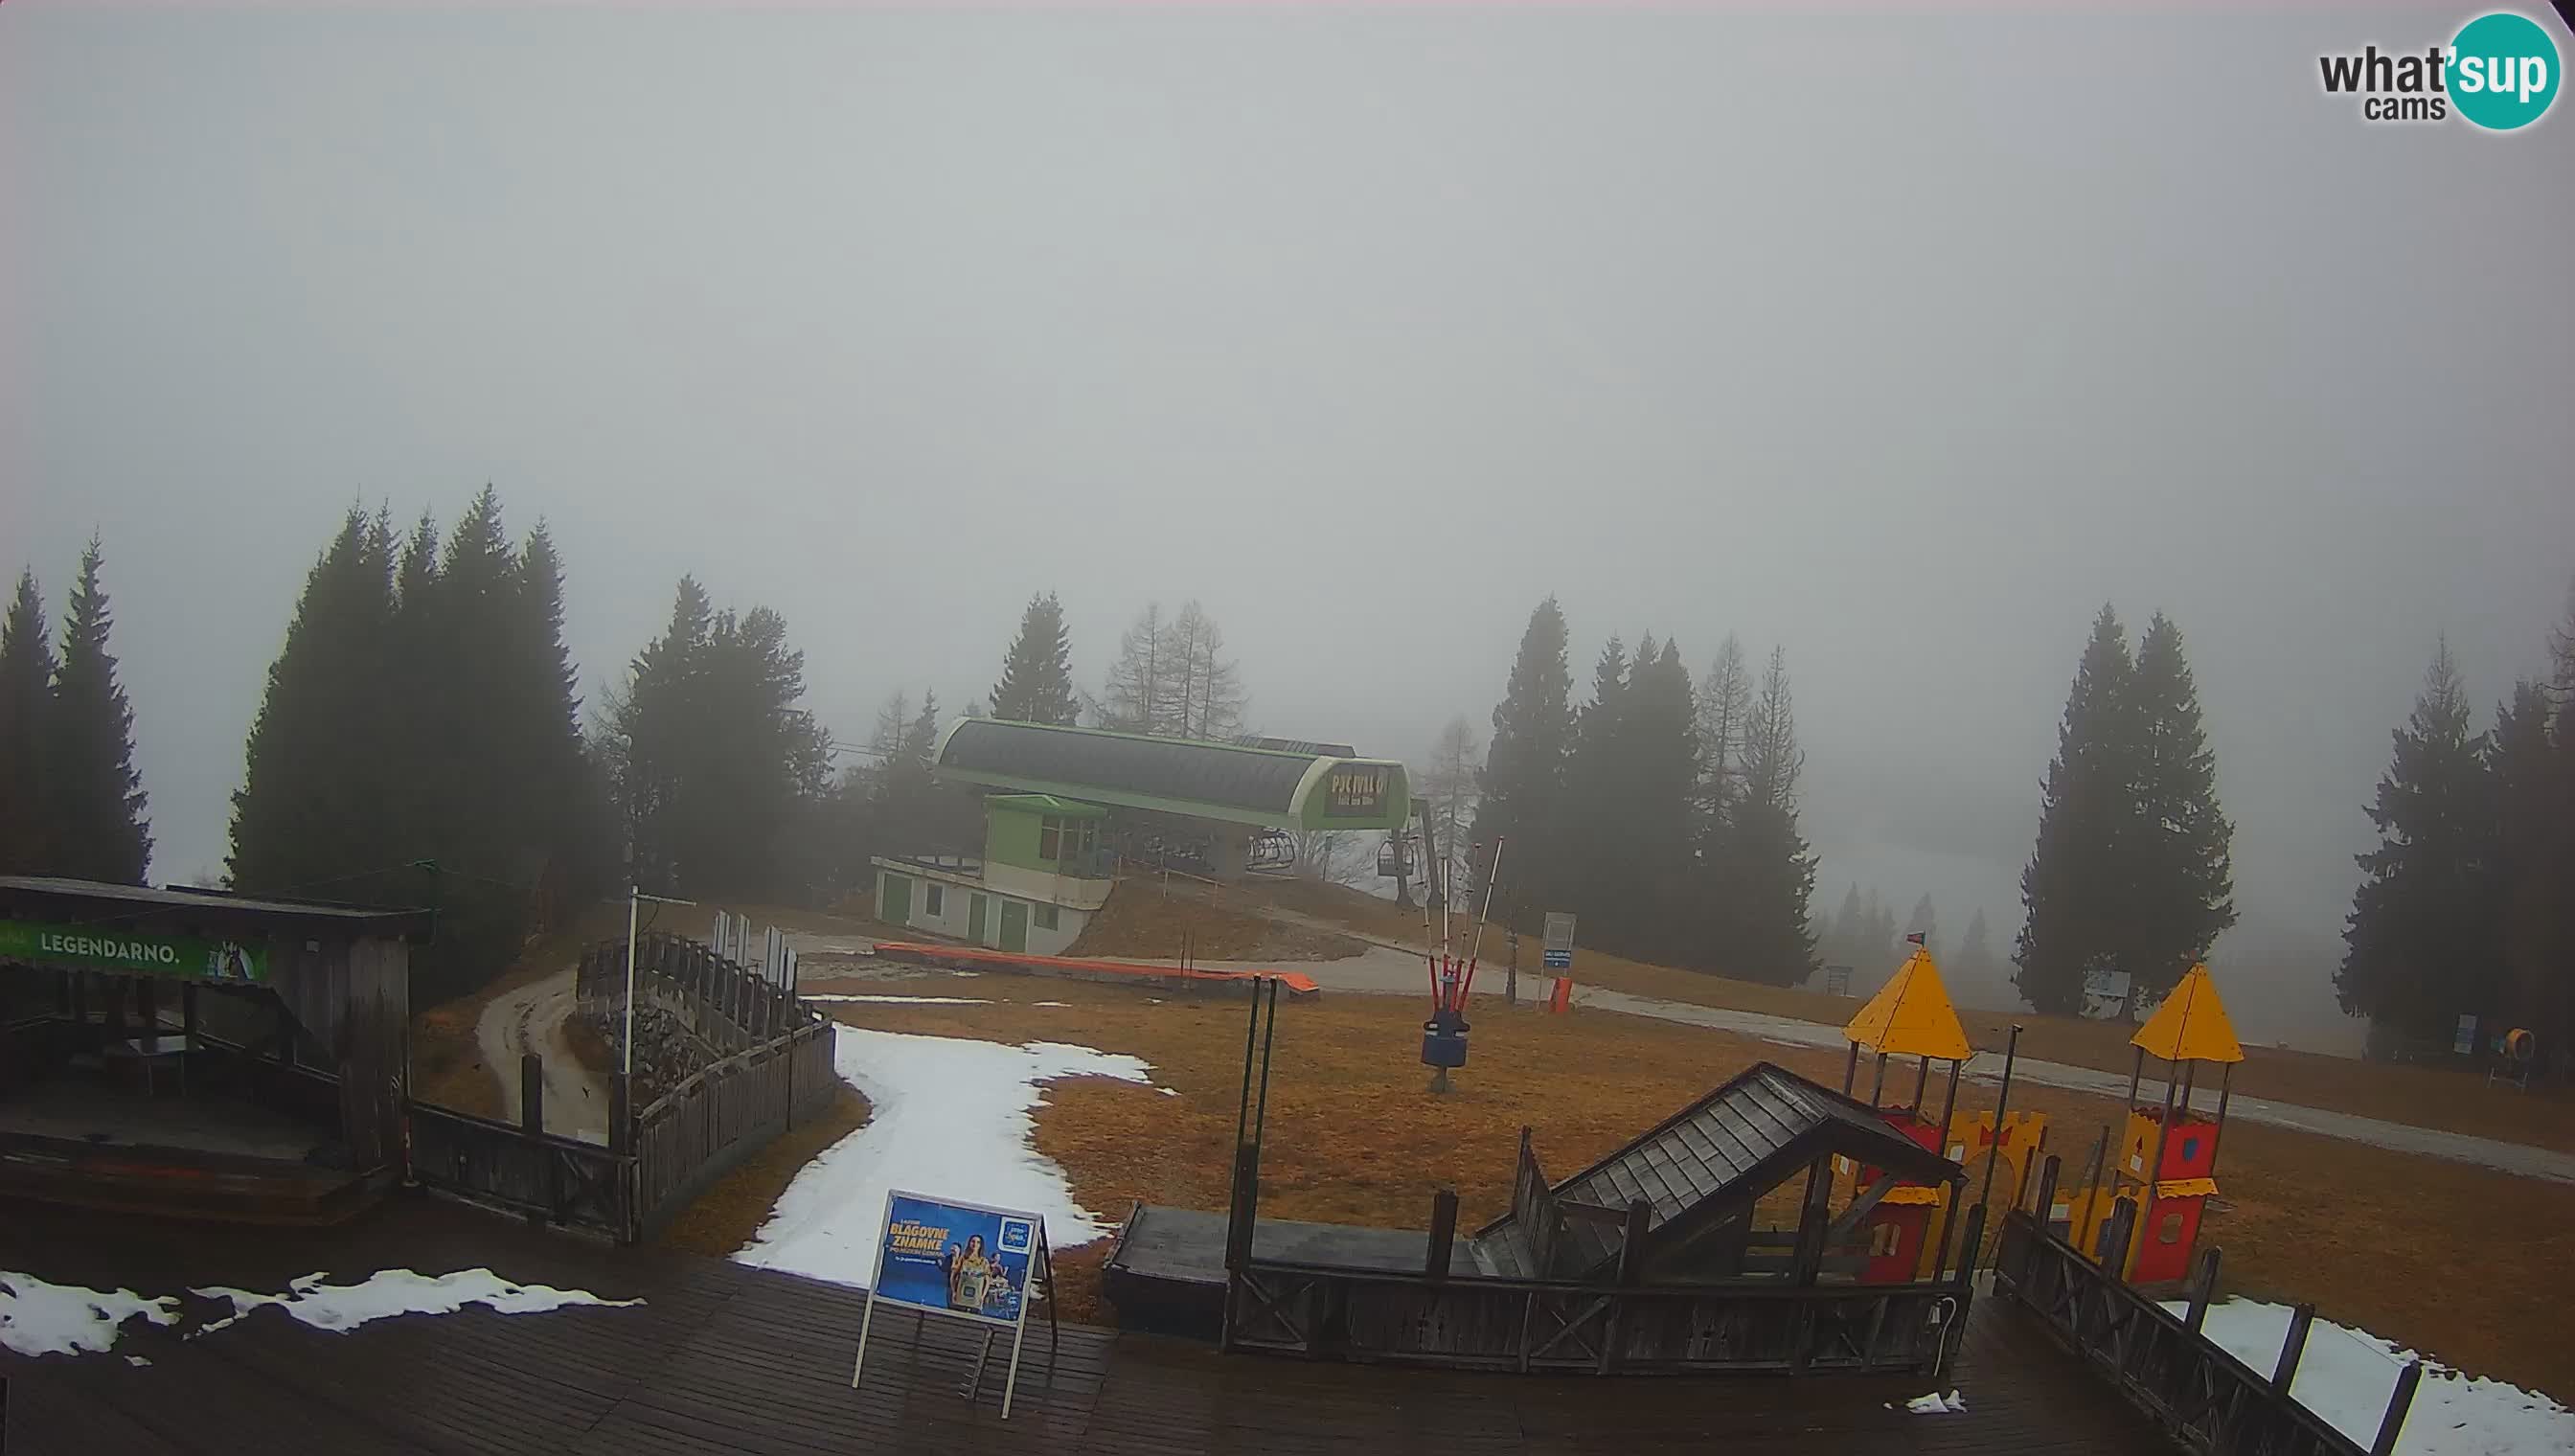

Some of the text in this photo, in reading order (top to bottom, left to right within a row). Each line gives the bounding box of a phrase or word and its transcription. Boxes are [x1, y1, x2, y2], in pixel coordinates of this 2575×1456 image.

[41, 932, 181, 965] LEGENDARNO.
[890, 1222, 950, 1240] BLAGOVNE
[892, 1235, 944, 1251] ZNAMKE
